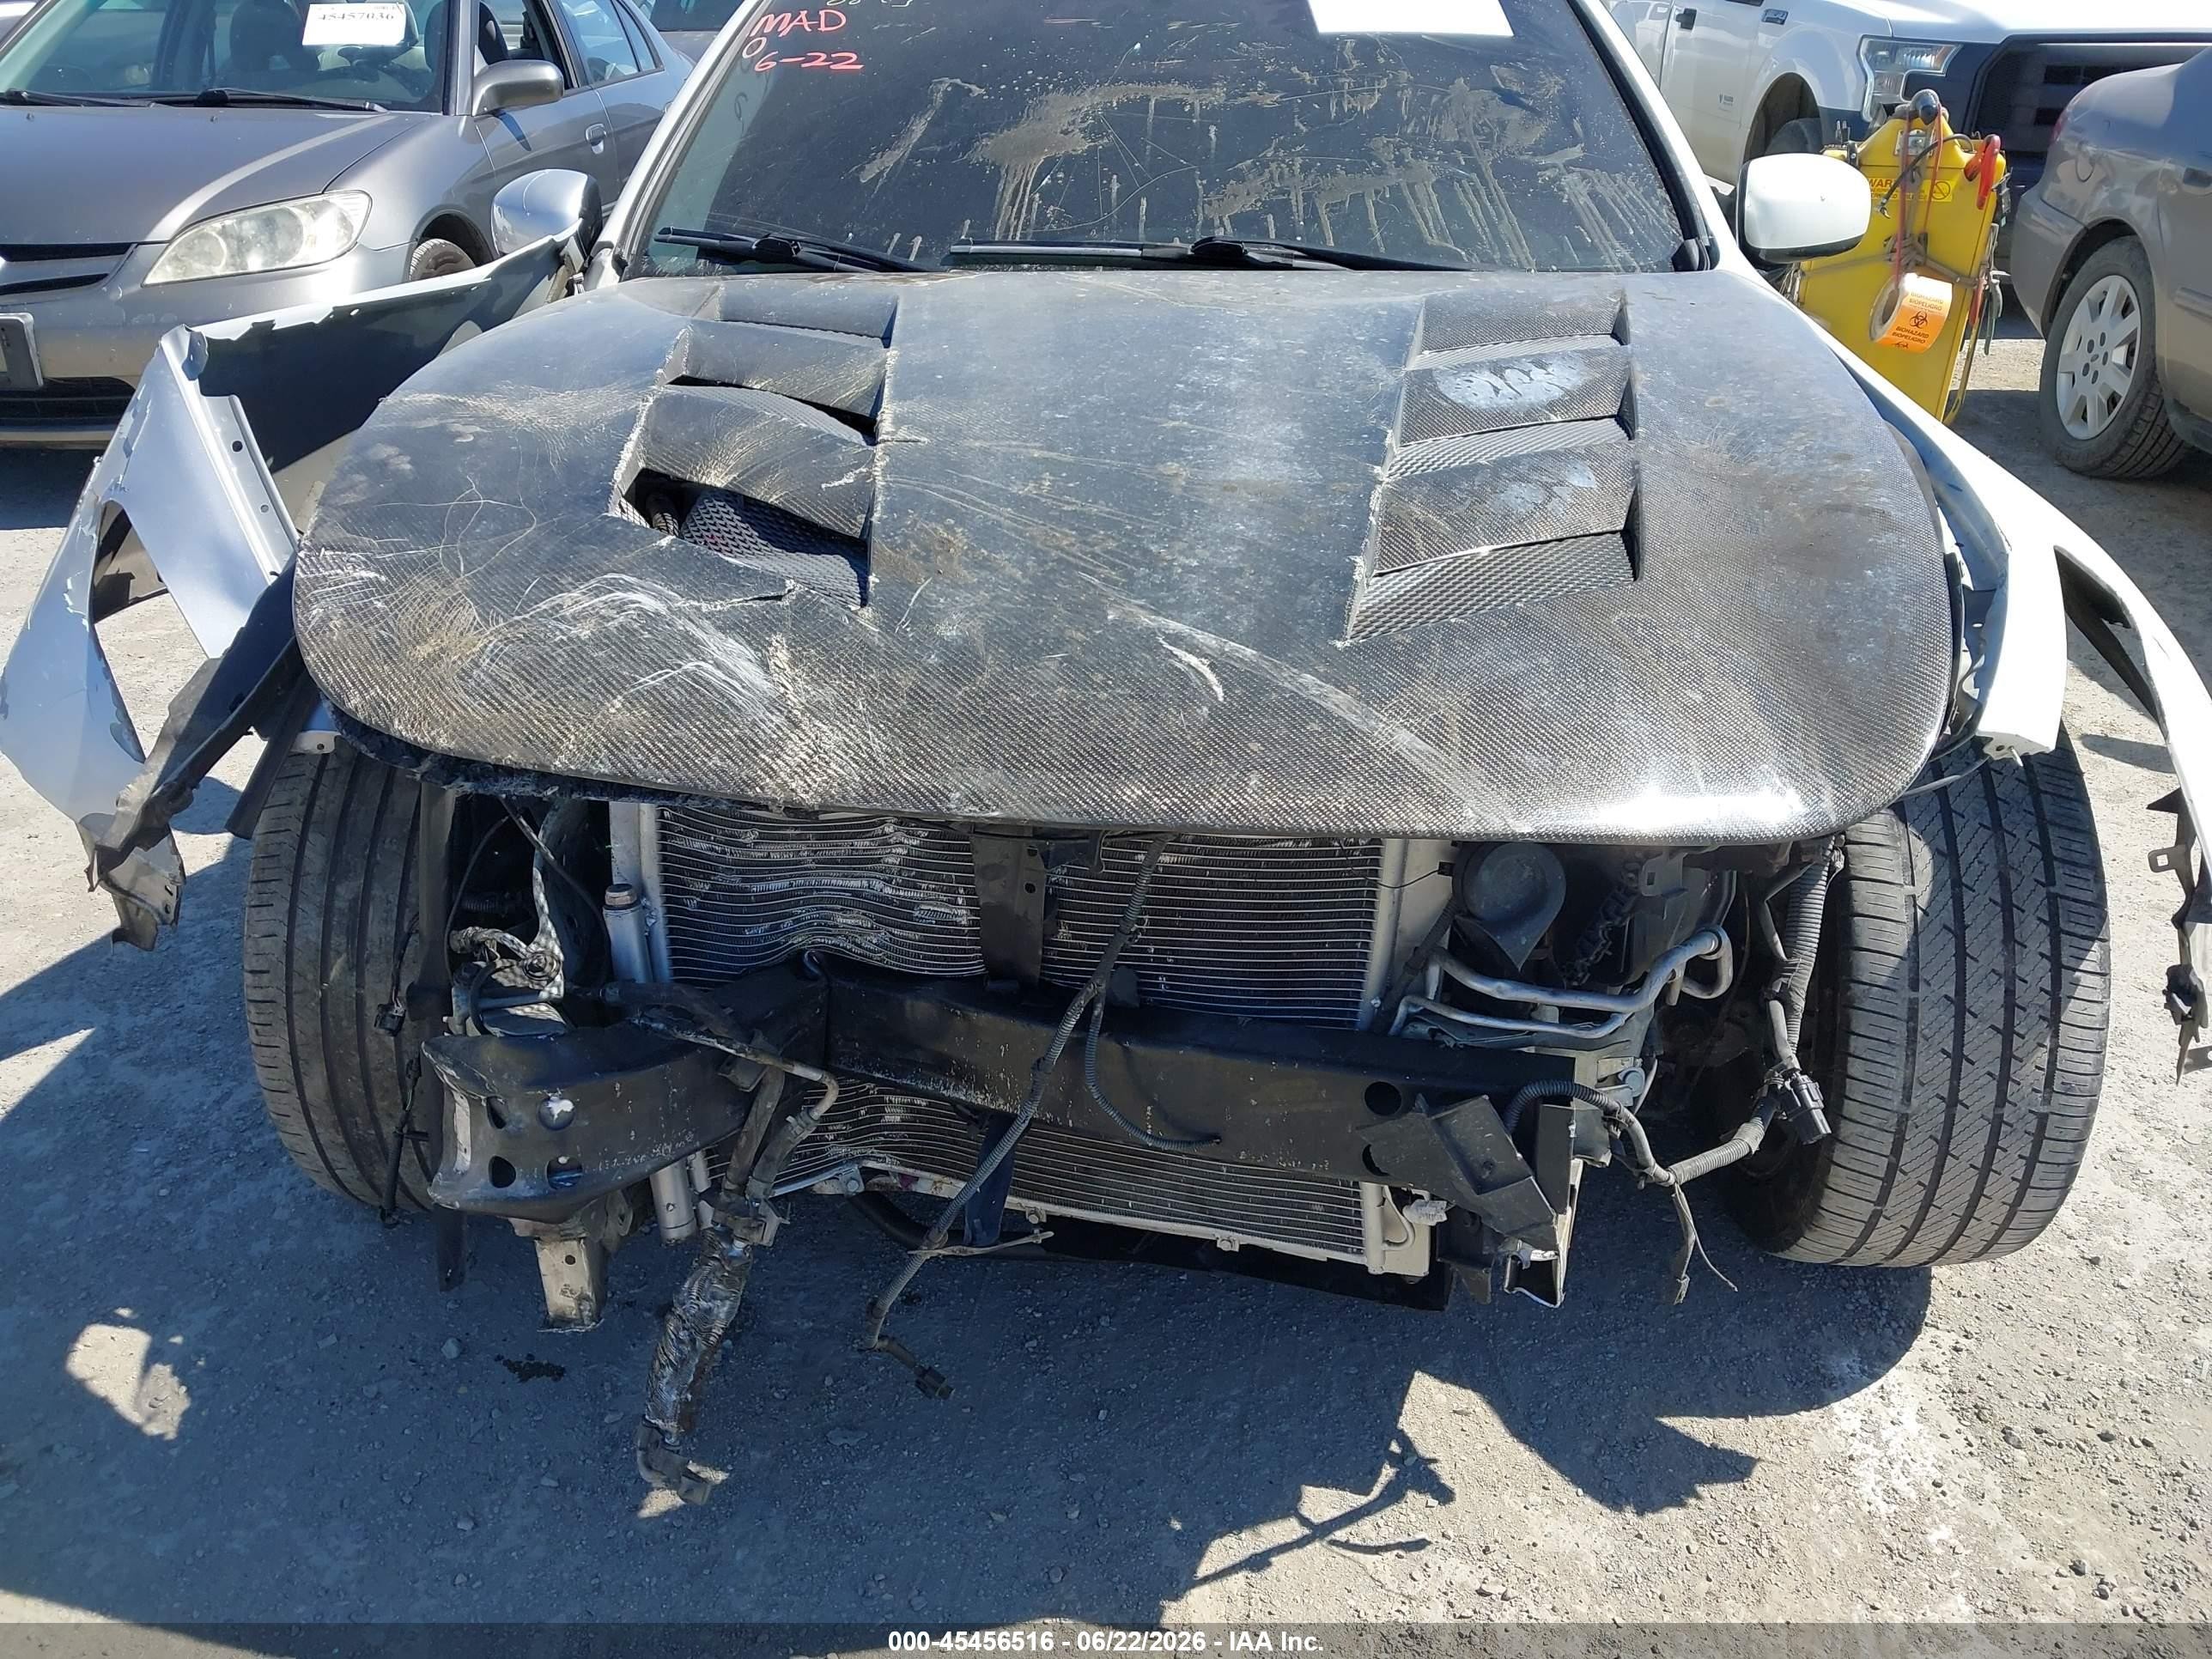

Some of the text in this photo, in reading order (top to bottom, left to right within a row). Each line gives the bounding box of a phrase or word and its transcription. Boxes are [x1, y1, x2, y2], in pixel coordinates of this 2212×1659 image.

[750, 9, 847, 37] MAD
[1909, 298, 1942, 311] BIOPELIGRO
[1892, 331, 1926, 344] BIOPELIGRO
[1896, 325, 1929, 338] BIOHAZARD
